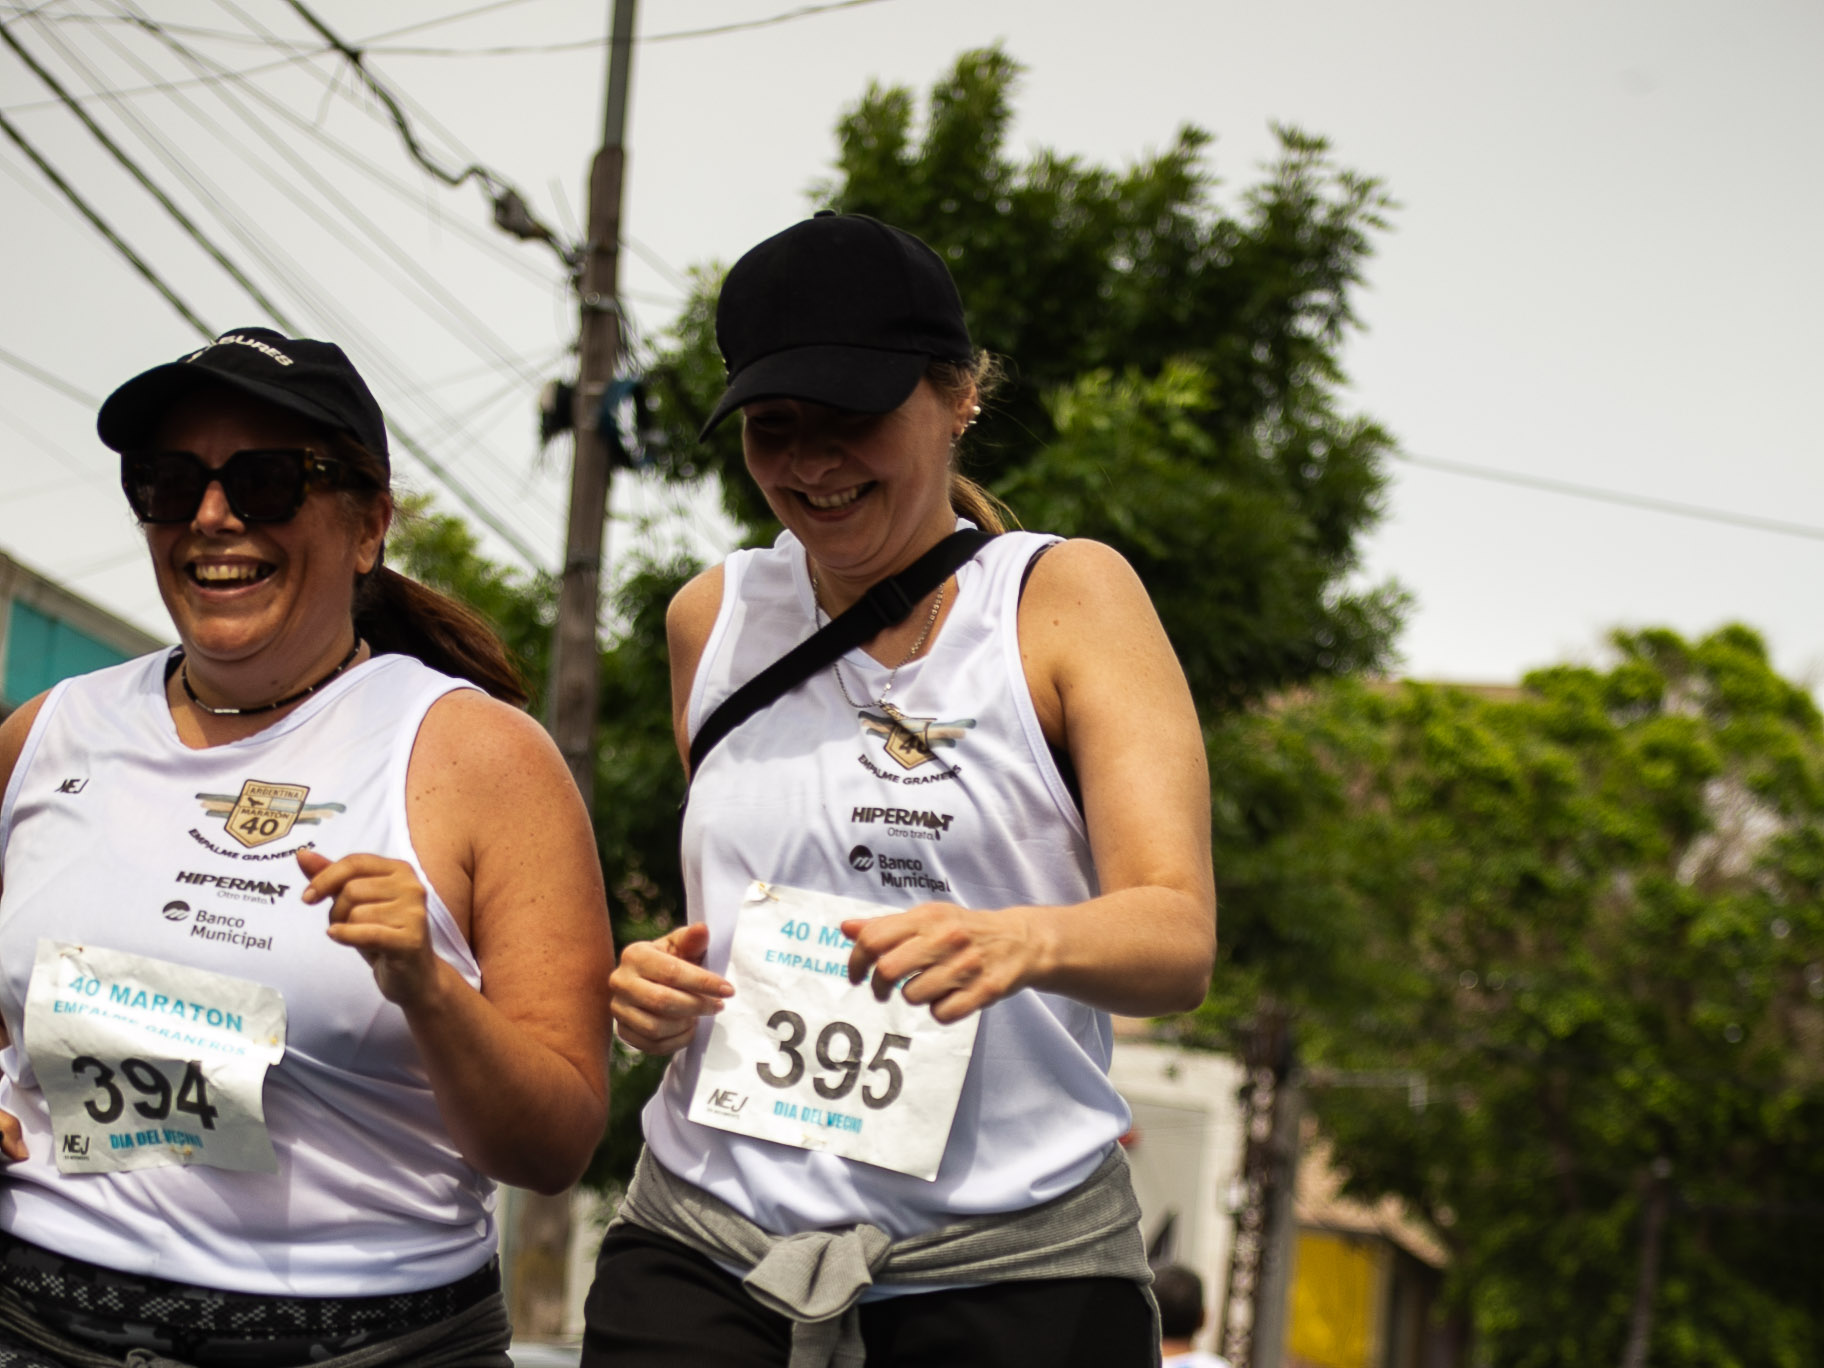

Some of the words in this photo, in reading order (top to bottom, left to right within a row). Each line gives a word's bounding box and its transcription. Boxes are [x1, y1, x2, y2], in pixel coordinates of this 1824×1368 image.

[858, 754, 900, 783] EMPALME
[902, 765, 962, 785] GRANES
[240, 817, 279, 836] 40
[887, 827, 909, 838] Otro
[188, 828, 239, 859] EMPALME
[878, 854, 922, 871] Banco
[881, 871, 951, 893] Municipal
[217, 890, 240, 900] Otro
[195, 910, 245, 928] Banco
[781, 920, 810, 941] 40
[190, 925, 273, 951] Municipal
[765, 949, 848, 978] EMPALME
[69, 975, 100, 997] 40
[109, 984, 243, 1033] MARATON
[145, 1024, 246, 1056] GRANEROS
[756, 1010, 912, 1110] 395
[71, 1055, 219, 1130] 394
[773, 1100, 797, 1120] DIA
[801, 1106, 823, 1126] DEL
[62, 1133, 90, 1155] NEJ
[109, 1133, 135, 1150] DIA
[135, 1129, 162, 1146] DEL
